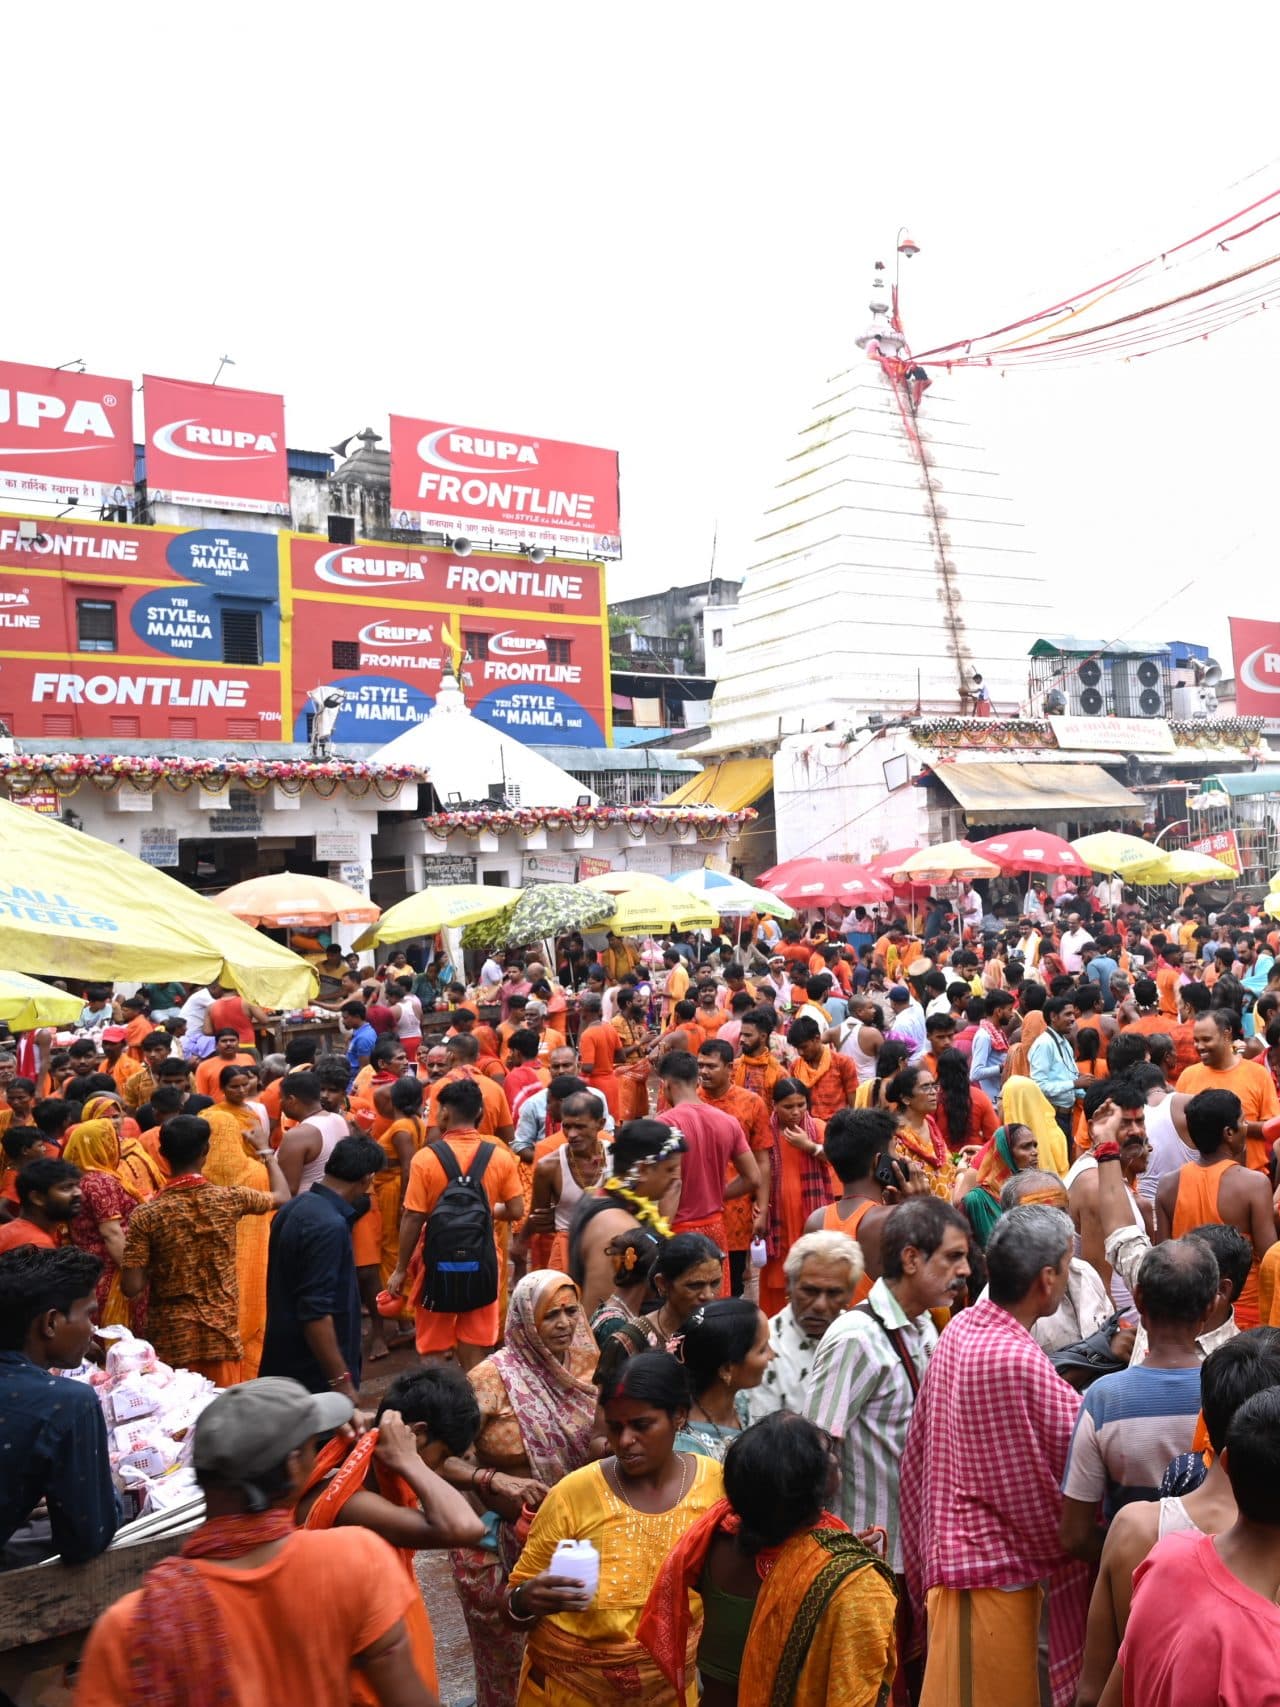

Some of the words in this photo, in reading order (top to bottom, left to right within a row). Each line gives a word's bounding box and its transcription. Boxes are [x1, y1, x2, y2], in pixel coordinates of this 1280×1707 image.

[0, 388, 114, 438] PA
[186, 425, 277, 452] RUPA
[449, 434, 538, 464] RUPA
[418, 472, 594, 519] FRONTLINE
[515, 514, 540, 522] STYLE
[551, 518, 580, 527] MAMLA
[0, 529, 139, 561] FRONTLINE
[190, 544, 237, 558] STYLE
[192, 557, 249, 571] MAMLA
[342, 556, 425, 580] RUPA
[446, 566, 583, 600] FRONTLINE
[171, 598, 188, 607] YEH
[147, 607, 197, 621] STYLE
[196, 614, 210, 624] KA
[147, 622, 213, 639] MAMLA
[375, 626, 433, 643] RUPA
[501, 635, 547, 651] RUPA
[359, 654, 441, 670] FRONTLINE
[484, 660, 582, 683] FRONTLINE
[31, 672, 249, 707] FRONTLINE
[360, 686, 407, 705] STYLE
[511, 695, 556, 710] STYLE
[355, 704, 417, 722] MAMLA
[492, 708, 506, 717] KA
[506, 711, 563, 726] MAMLA
[0, 901, 119, 931] TEELS
